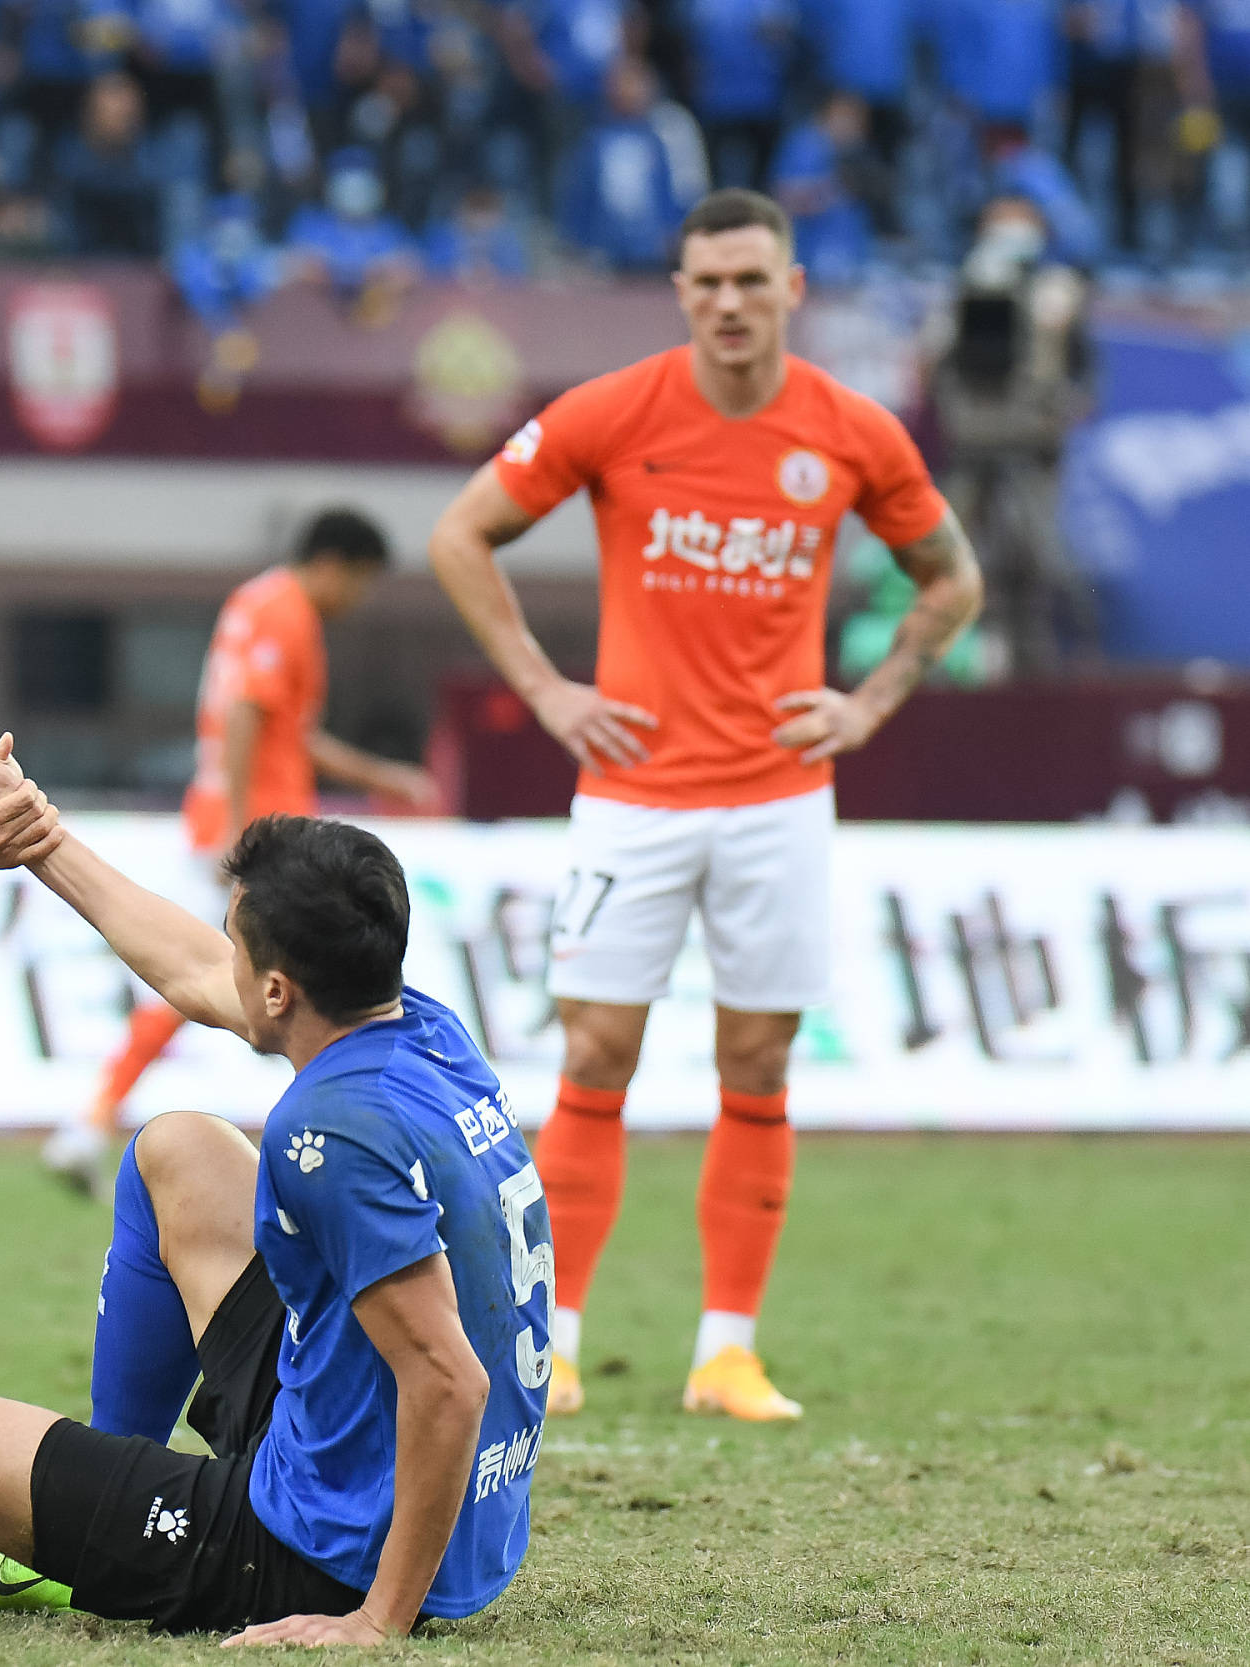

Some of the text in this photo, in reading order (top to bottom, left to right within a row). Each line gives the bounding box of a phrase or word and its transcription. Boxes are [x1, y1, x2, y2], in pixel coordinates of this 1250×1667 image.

[544, 867, 614, 938] 27
[498, 1161, 556, 1389] 5
[143, 1496, 163, 1539] KELME
